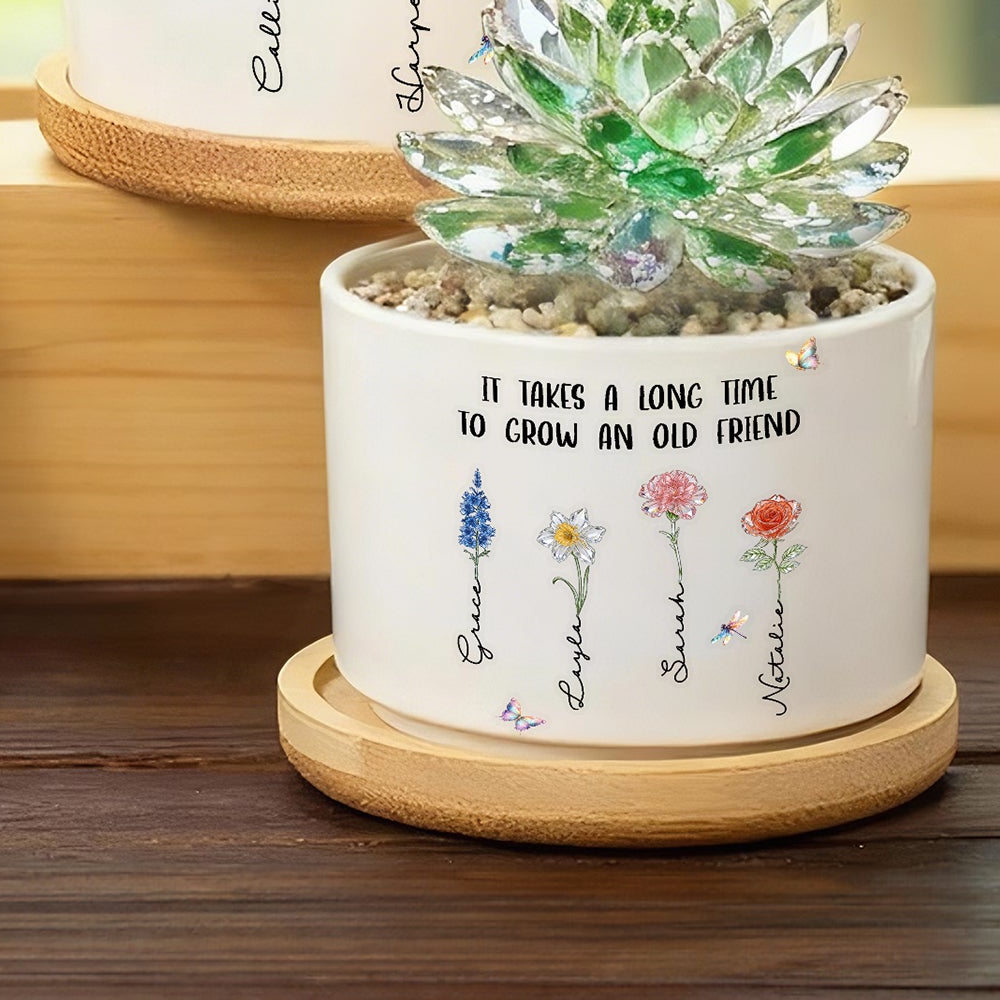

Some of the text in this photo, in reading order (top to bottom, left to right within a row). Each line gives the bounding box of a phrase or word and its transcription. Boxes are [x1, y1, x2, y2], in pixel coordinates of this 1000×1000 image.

[457, 408, 801, 450] TO GROW AN OLD FRIEND
[481, 374, 778, 412] IT TAKES A LONG TIME
[457, 575, 494, 665] Grace
[558, 614, 591, 711] Layla
[660, 582, 689, 684] Sarah
[757, 599, 791, 716] Natalie
